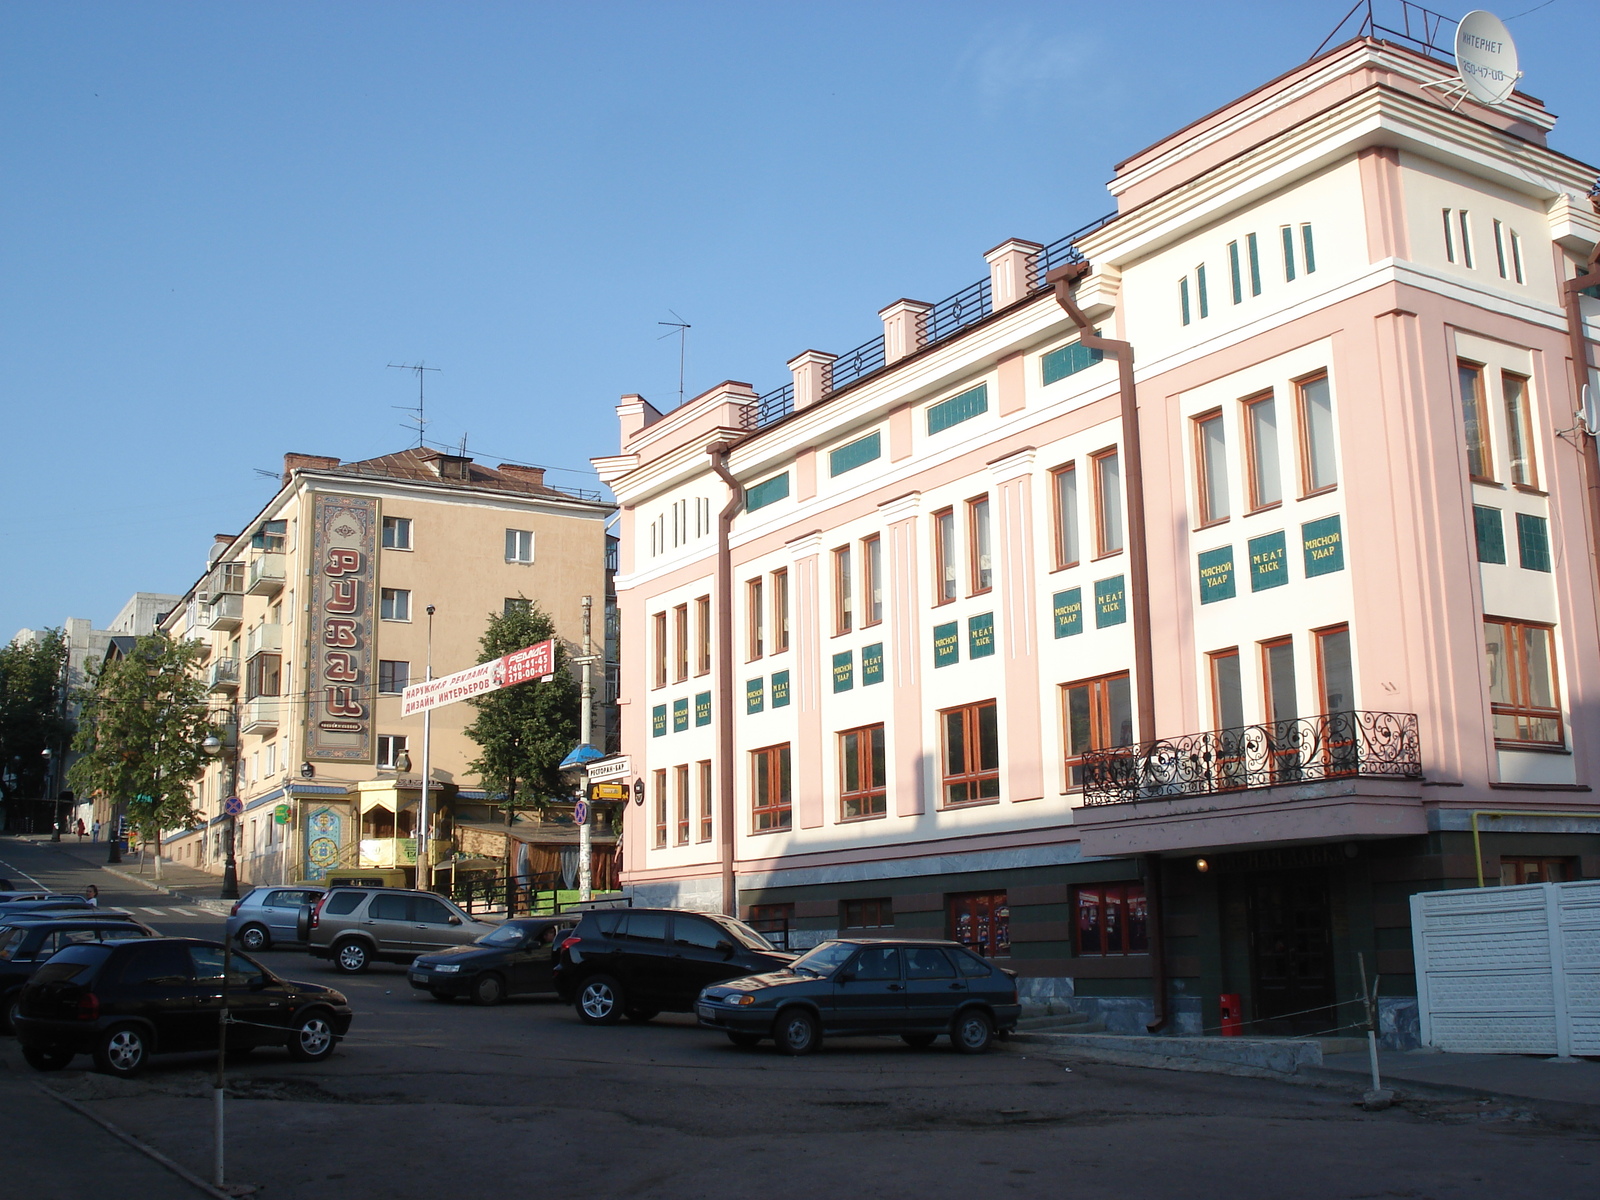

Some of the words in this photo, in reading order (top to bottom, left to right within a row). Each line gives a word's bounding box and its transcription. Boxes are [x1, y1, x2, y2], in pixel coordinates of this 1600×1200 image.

[1462, 31, 1502, 54] ИНТЕРНЕТ
[1305, 532, 1340, 550] МЯСНОЙ
[1253, 548, 1283, 564] MEAT
[1312, 546, 1335, 561] УДАР
[1201, 561, 1232, 578] МЯСНОЙ
[1258, 561, 1279, 574] KICK
[1207, 574, 1228, 588] УДАР
[1098, 591, 1123, 605] MEAT
[1054, 602, 1081, 617] МЯСНОЙ
[1102, 602, 1120, 614] KICK
[1059, 613, 1077, 626] УДАР
[972, 626, 993, 638] MEAT
[975, 636, 991, 647] KICK
[507, 654, 549, 674] 240-41-45
[863, 655, 882, 667] MEAT
[450, 665, 489, 686] РЕКЛАМА
[508, 664, 548, 683] 278-00-41
[405, 695, 435, 715] ДИЗАЙН
[438, 678, 490, 703] ИНТЕРЬЕРОВ
